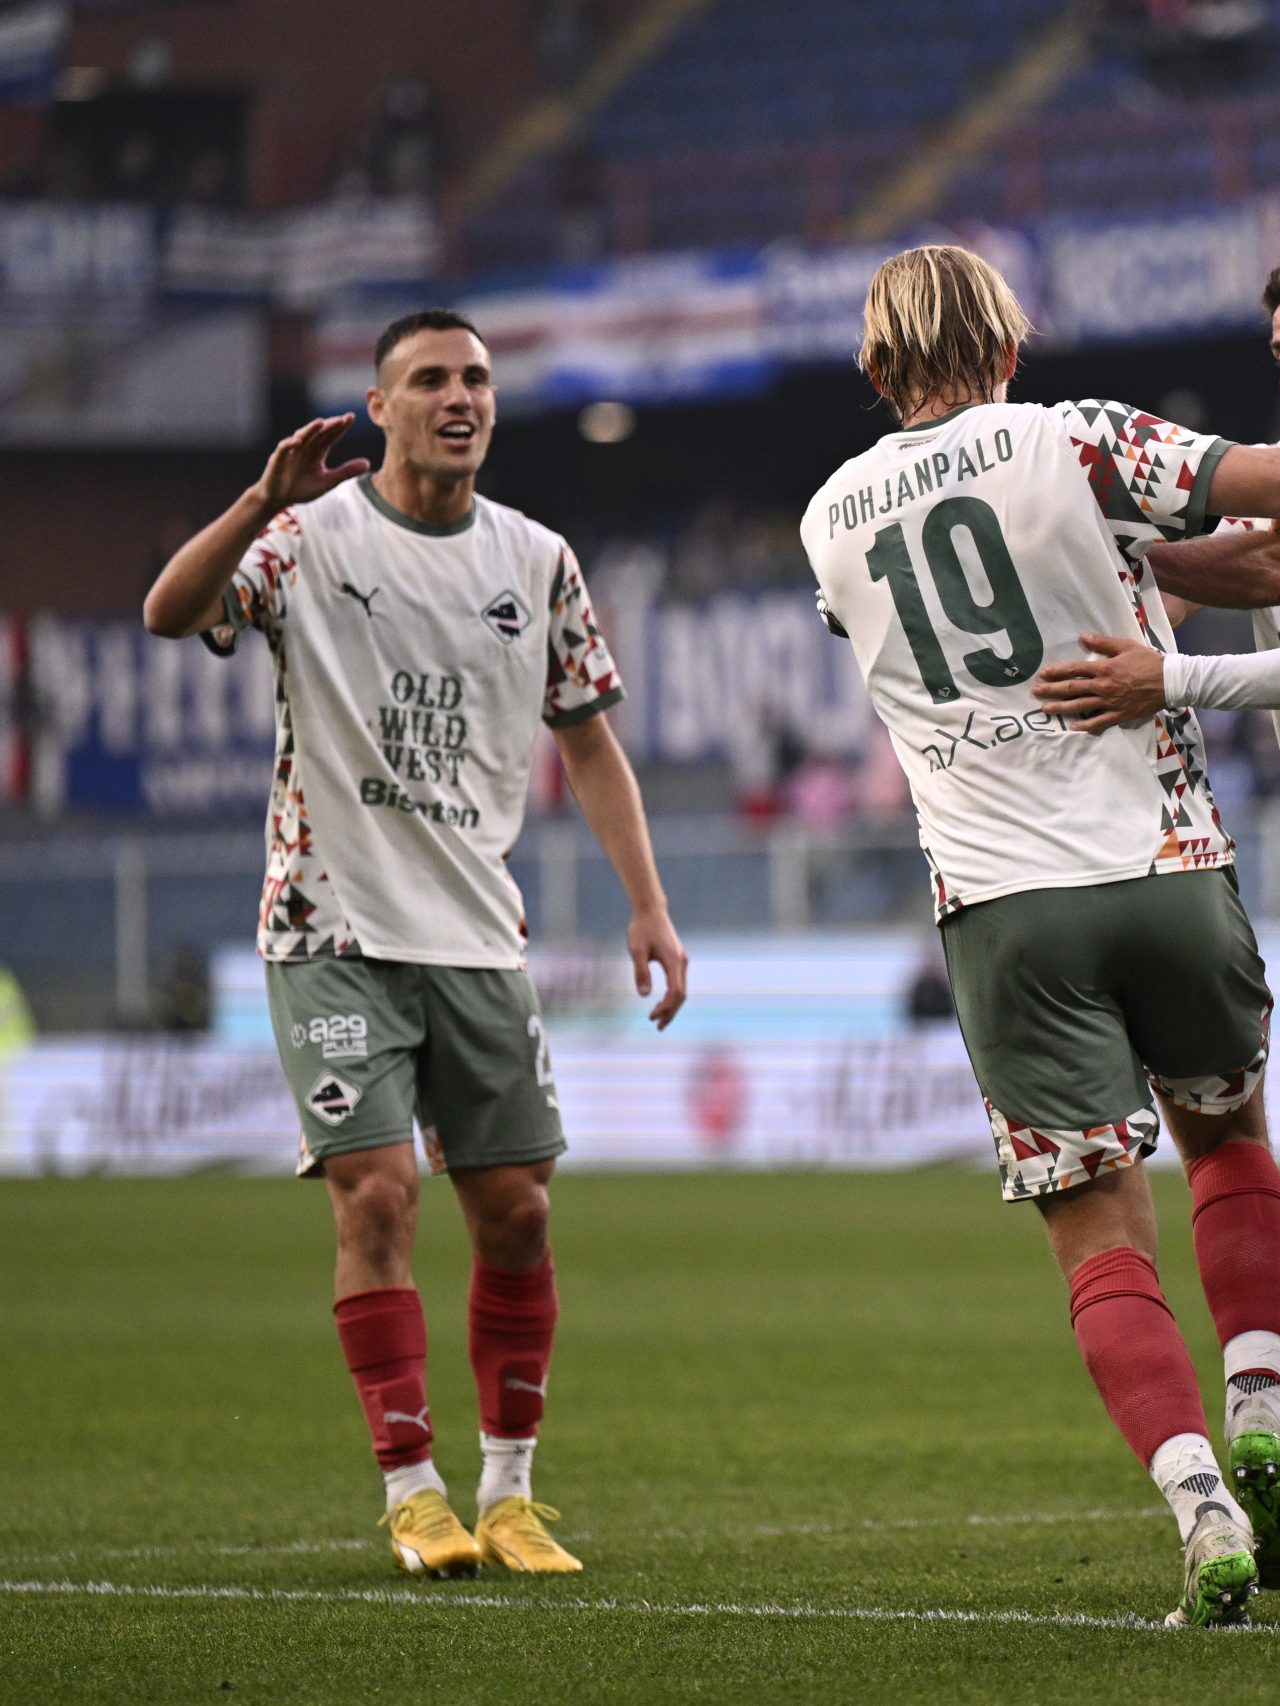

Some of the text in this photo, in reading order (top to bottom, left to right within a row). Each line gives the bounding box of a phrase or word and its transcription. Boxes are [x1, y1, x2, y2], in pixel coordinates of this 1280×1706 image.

[828, 428, 1013, 540] POHJANPALO
[865, 496, 1044, 705] 19
[391, 670, 462, 710] OLD
[379, 706, 466, 750] WILD
[309, 1013, 368, 1044] a29
